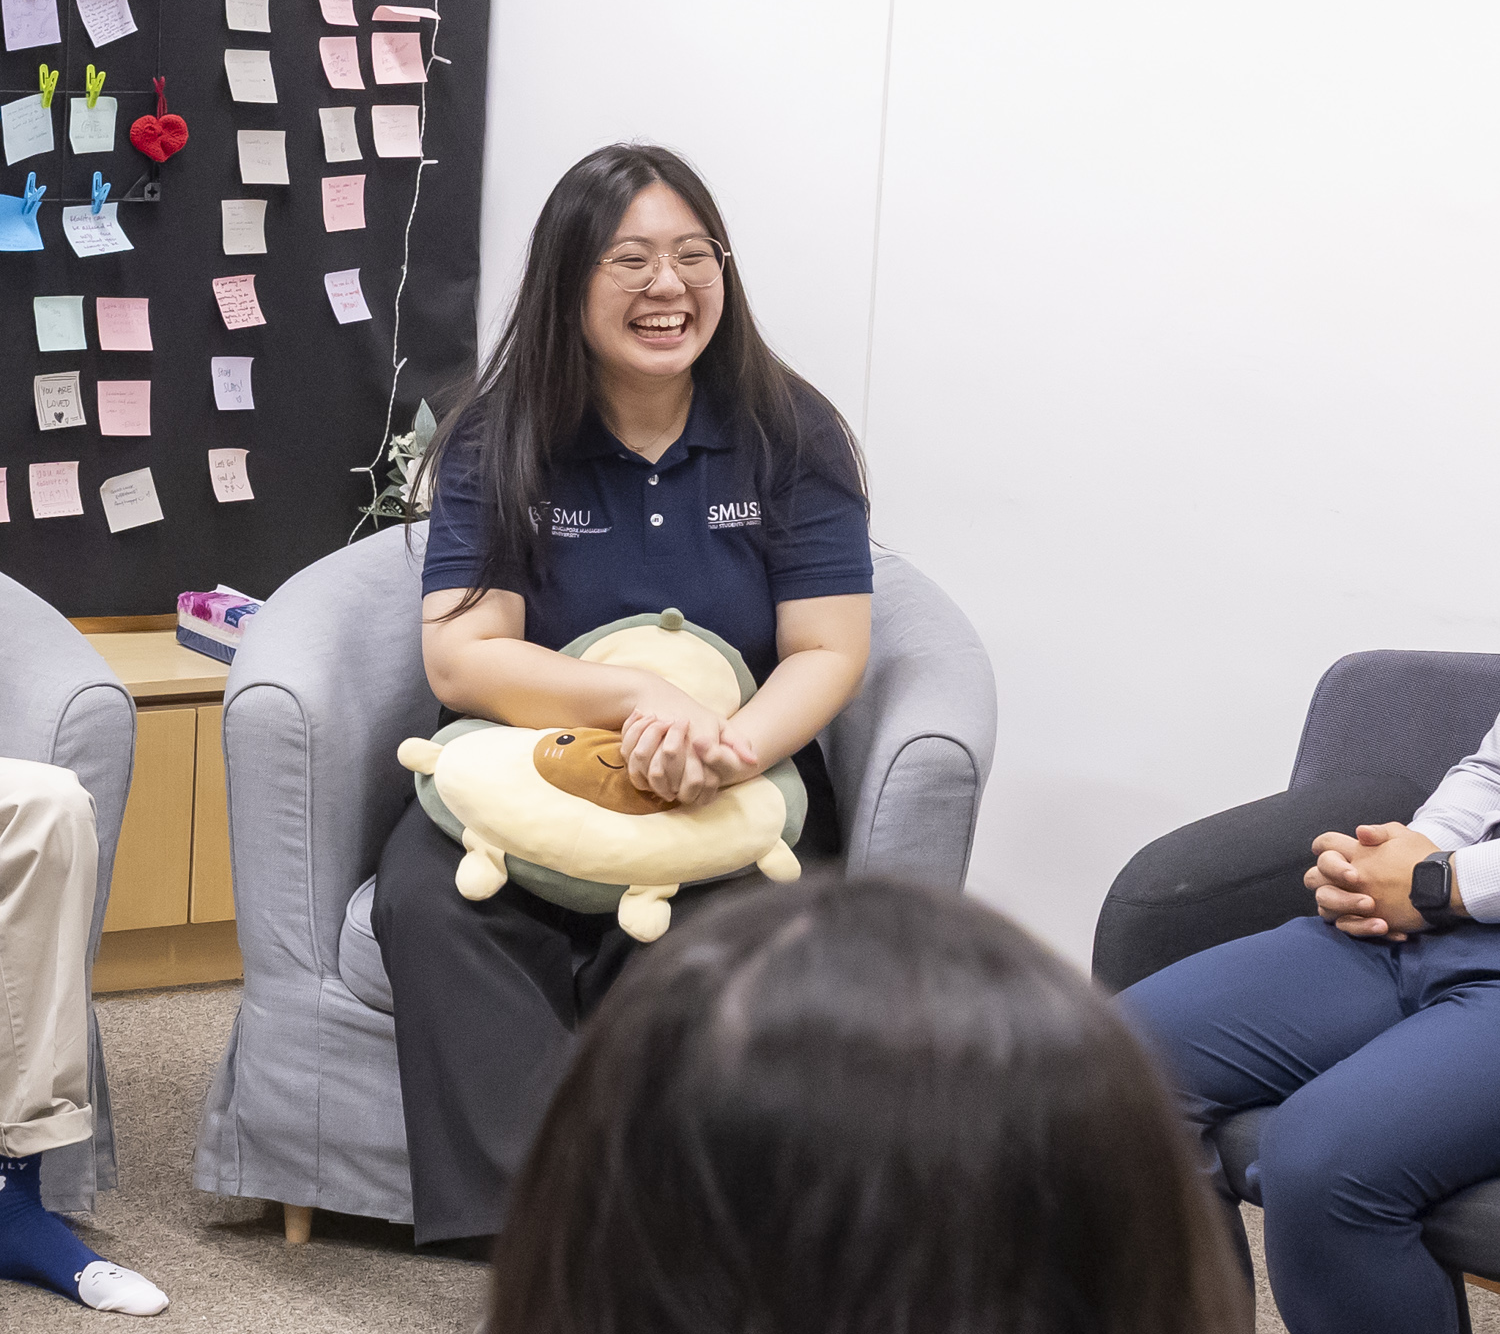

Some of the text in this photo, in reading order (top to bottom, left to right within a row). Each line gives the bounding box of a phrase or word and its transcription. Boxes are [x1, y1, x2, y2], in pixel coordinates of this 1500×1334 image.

[41, 385, 73, 396] YOU ARE
[46, 399, 70, 409] LOVED
[551, 507, 591, 526] SMU
